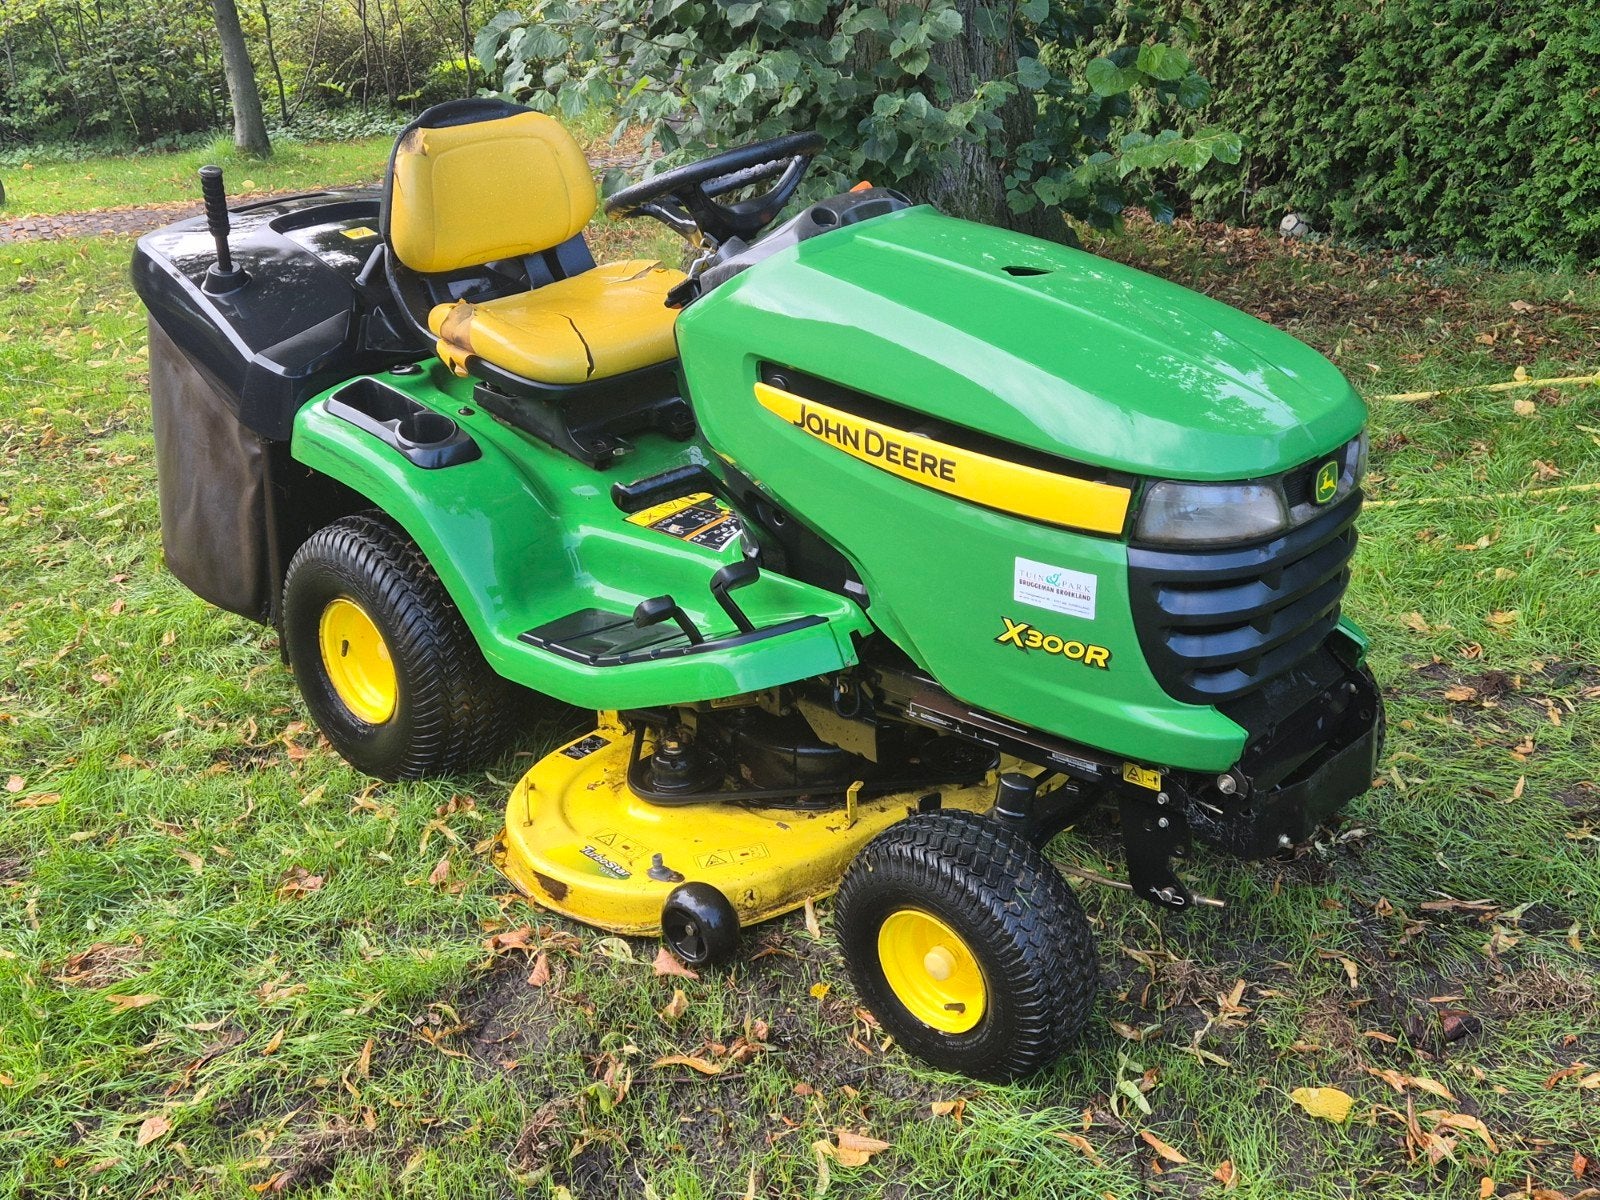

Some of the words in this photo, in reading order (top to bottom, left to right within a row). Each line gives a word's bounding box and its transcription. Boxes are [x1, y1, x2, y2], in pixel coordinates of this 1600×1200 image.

[793, 404, 859, 451] JOHN
[864, 428, 956, 483] DEERE
[1062, 580, 1091, 593] PARK
[994, 616, 1111, 671] X300R
